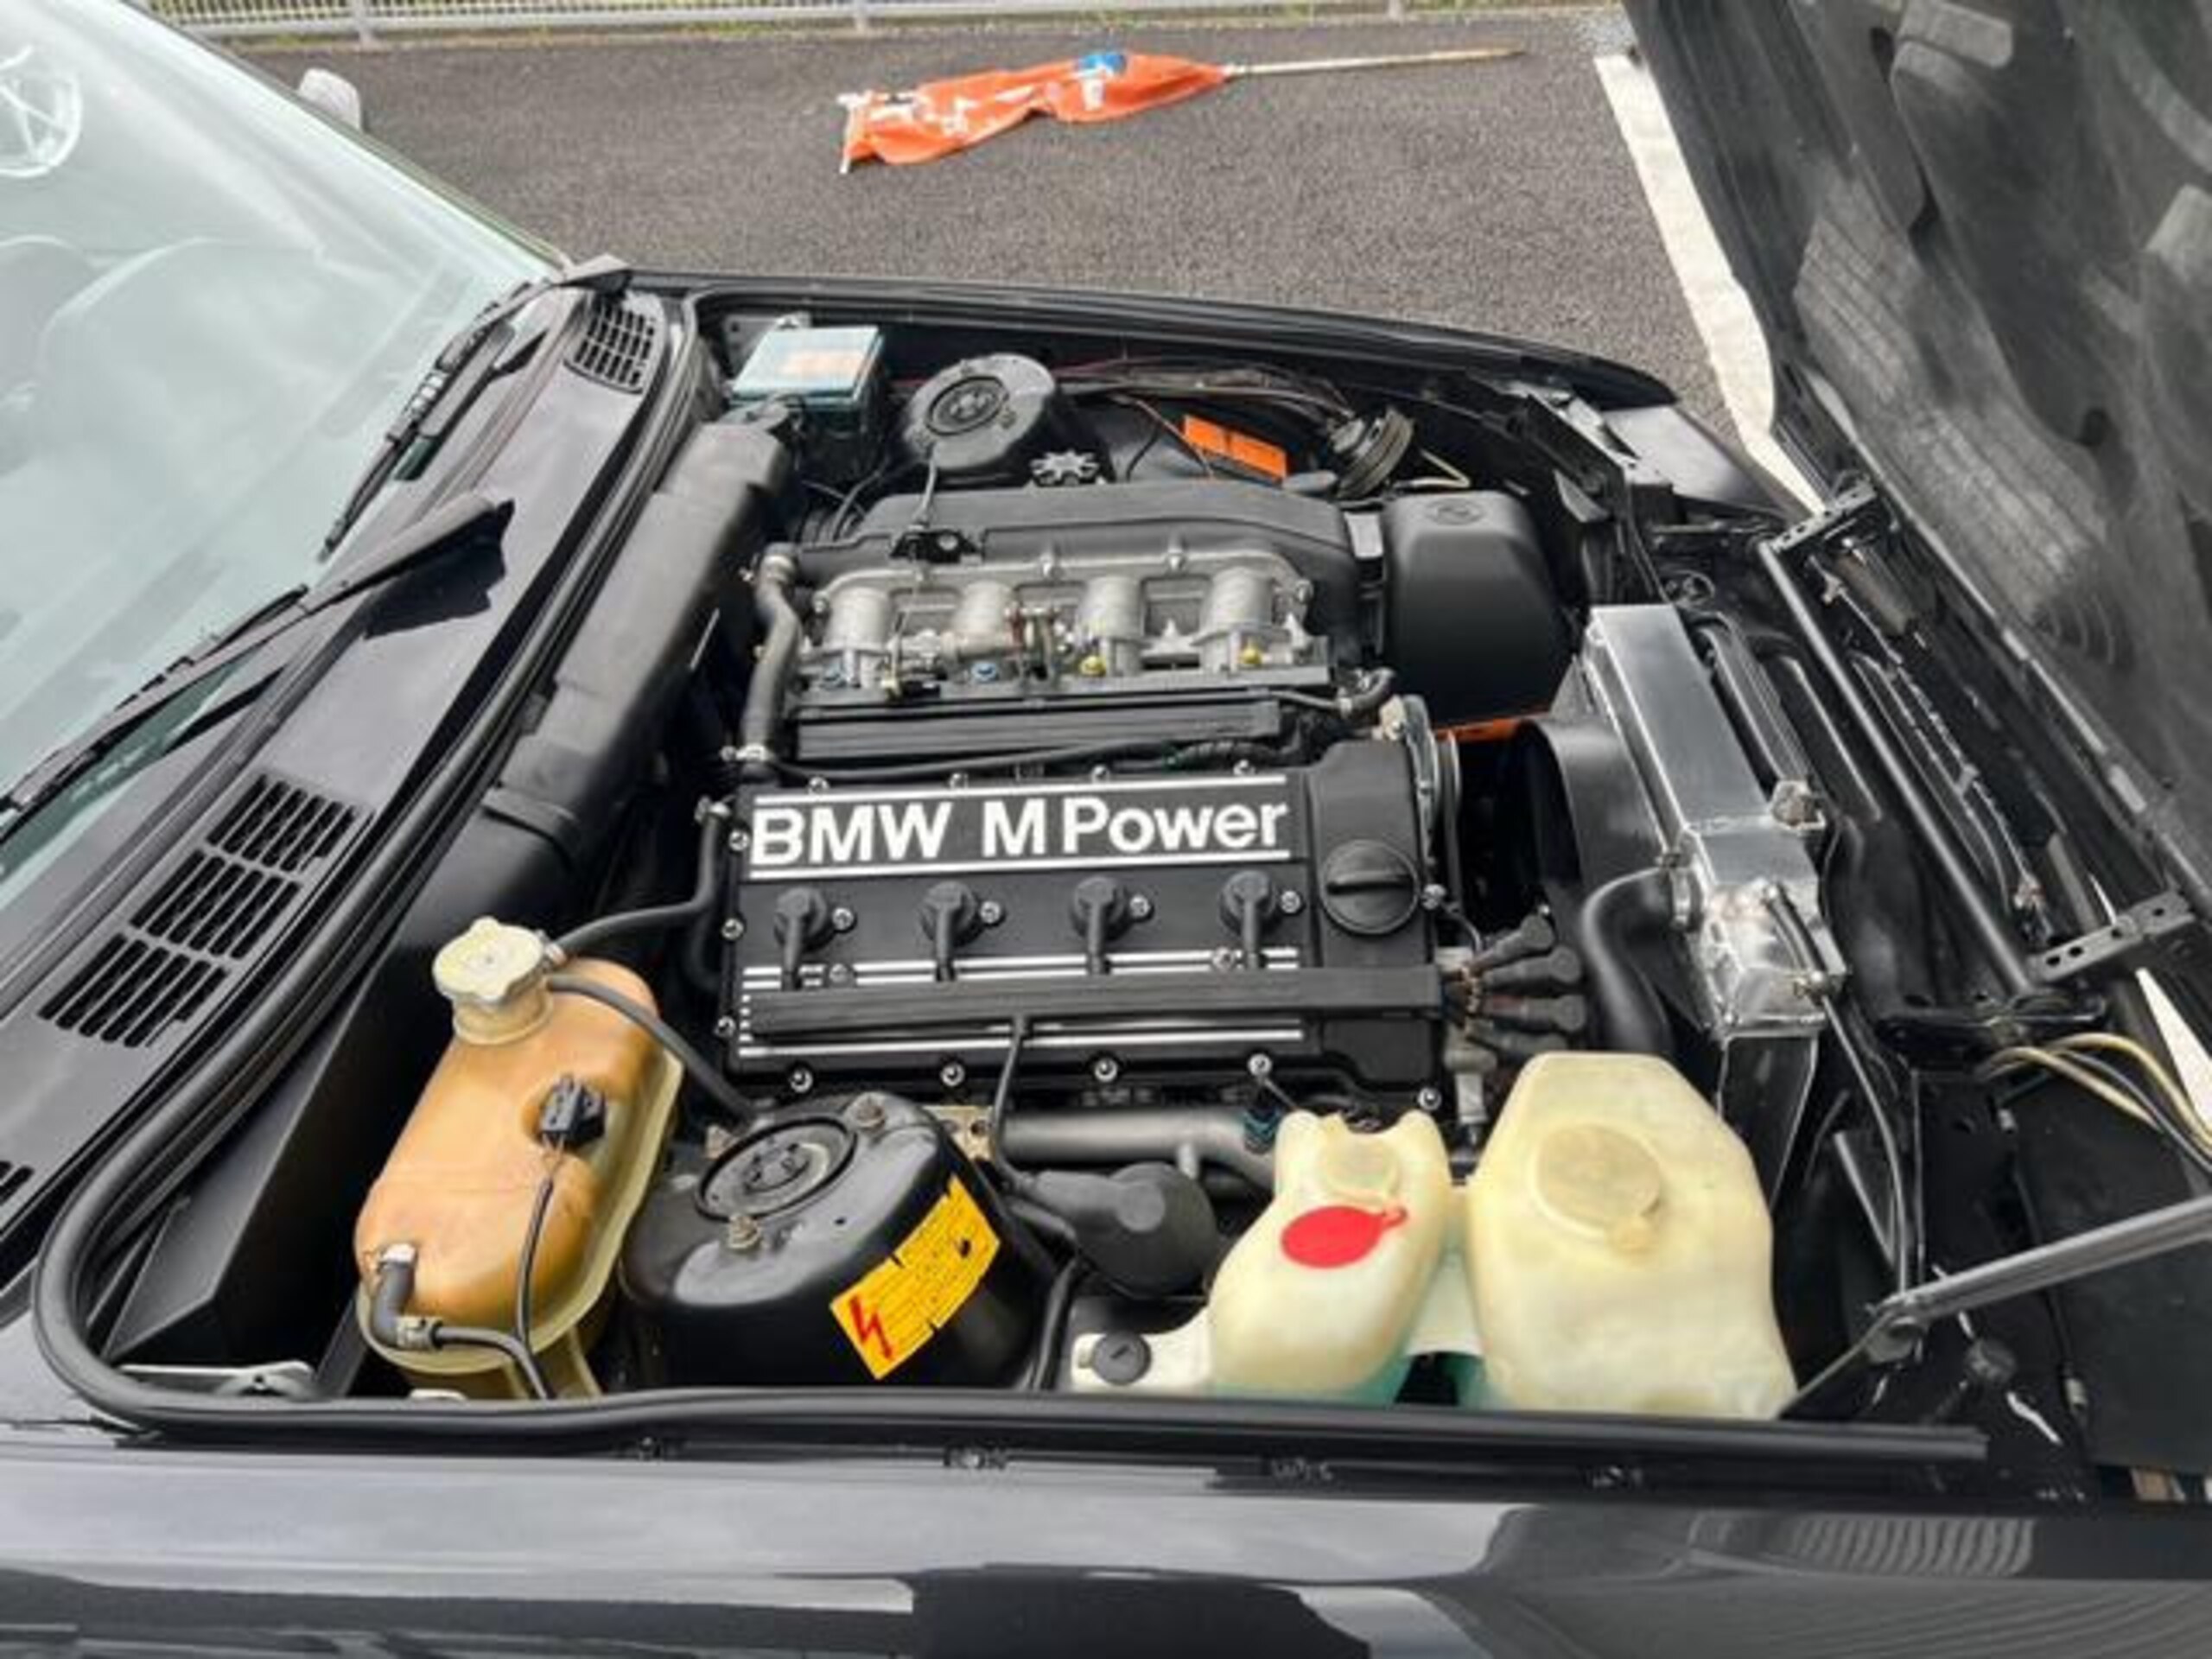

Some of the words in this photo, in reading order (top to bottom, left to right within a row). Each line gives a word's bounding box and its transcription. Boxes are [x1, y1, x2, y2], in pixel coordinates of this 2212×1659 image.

[749, 800, 954, 867] BMW
[982, 798, 1047, 858] M
[1062, 794, 1289, 855] Power
